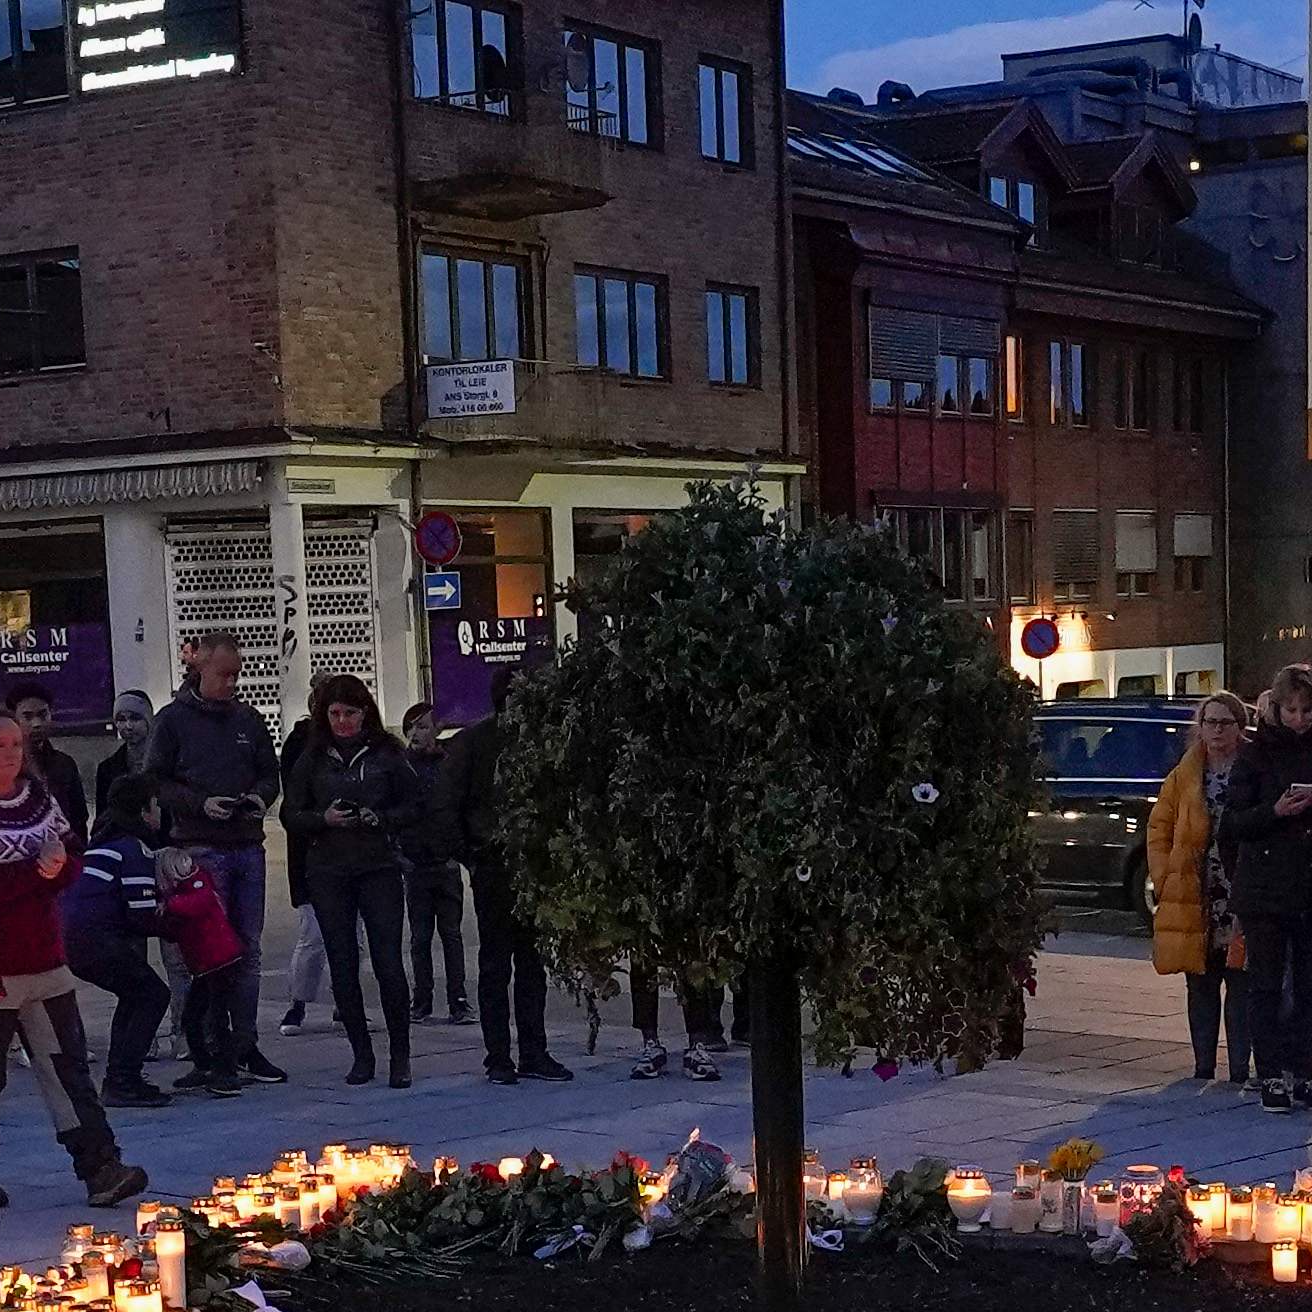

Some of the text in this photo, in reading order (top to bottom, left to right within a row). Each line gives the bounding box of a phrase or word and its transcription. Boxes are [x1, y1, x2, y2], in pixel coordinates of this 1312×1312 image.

[432, 363, 507, 377] KONTORLOKALER
[468, 377, 487, 387] LEIE
[0, 651, 70, 664] Callsenter
